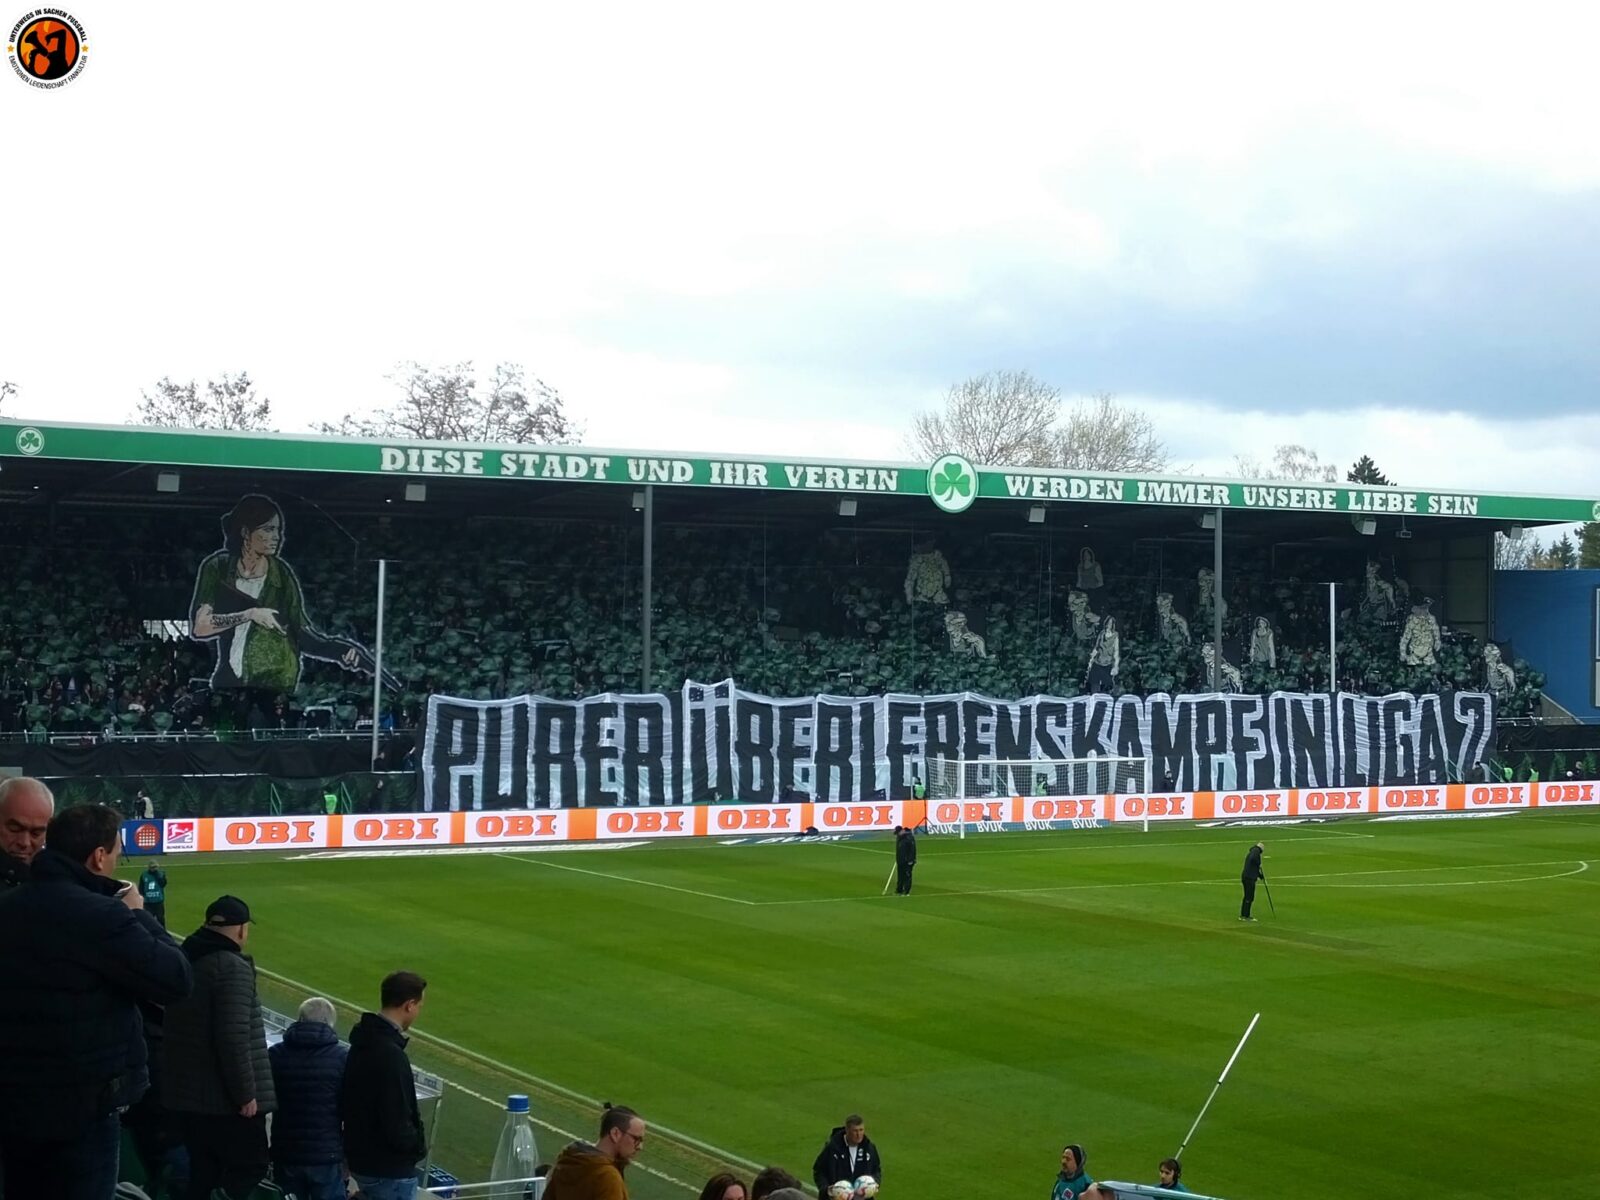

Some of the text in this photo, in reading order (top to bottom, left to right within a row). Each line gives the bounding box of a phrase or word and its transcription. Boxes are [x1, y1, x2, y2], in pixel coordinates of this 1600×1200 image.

[380, 447, 899, 492] DIESE STADT UND IHR VEREIN
[1004, 474, 1480, 516] WERDEN IMMER UNSERE LIEBE SEIN
[422, 694, 672, 810] PURER
[1269, 691, 1334, 789] IN
[1337, 691, 1449, 788] LIGA
[1453, 691, 1492, 785] 2
[1222, 794, 1279, 813] OBI
[1306, 791, 1360, 811] OBI
[1386, 789, 1438, 808] OBI
[1472, 786, 1522, 804] OBI
[1545, 784, 1593, 802] OBI
[823, 805, 892, 826] OBI
[936, 802, 1003, 823] OBI
[1032, 800, 1095, 820] OBI
[1123, 797, 1184, 817] OBI
[476, 815, 556, 837] OBI
[607, 811, 682, 833] OBI
[718, 808, 790, 829] OBI
[227, 821, 313, 845] OBI
[355, 819, 437, 841] OBI
